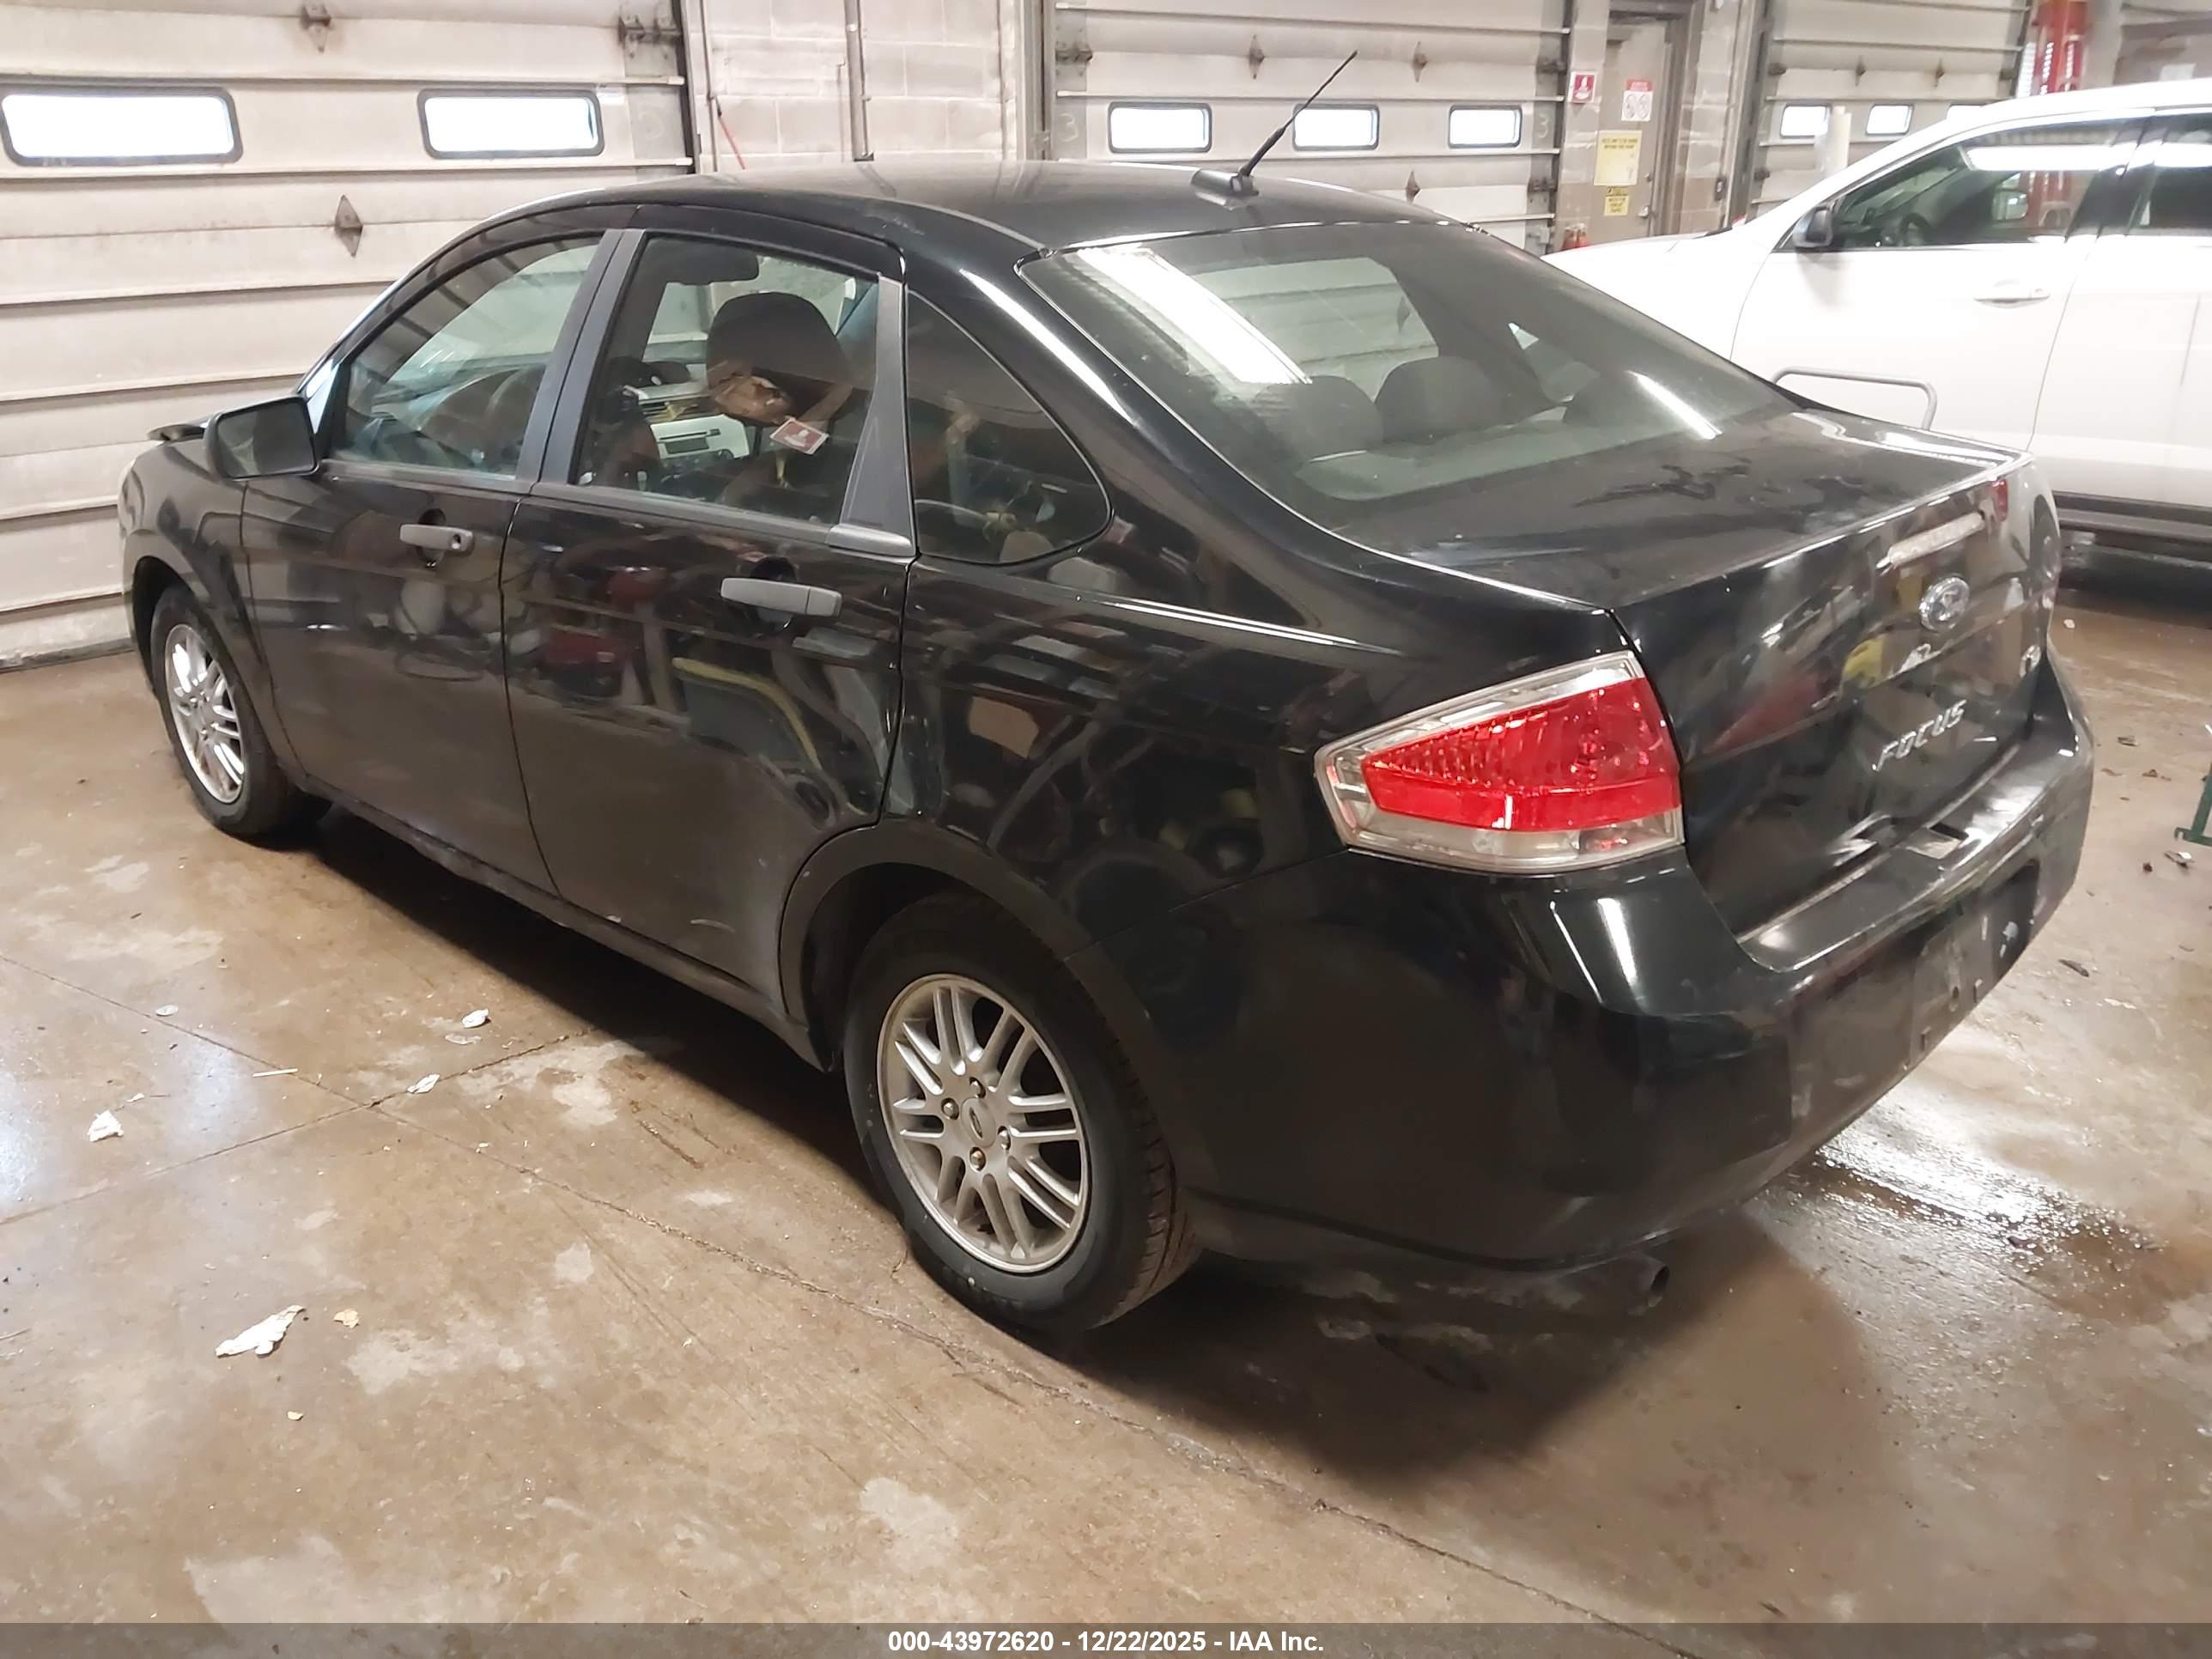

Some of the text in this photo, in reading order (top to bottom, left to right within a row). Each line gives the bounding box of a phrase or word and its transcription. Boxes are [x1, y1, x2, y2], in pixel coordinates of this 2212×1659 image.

[1057, 112, 1079, 143] 3
[1536, 112, 1550, 140] 3
[1875, 698, 1967, 771] FOCUS
